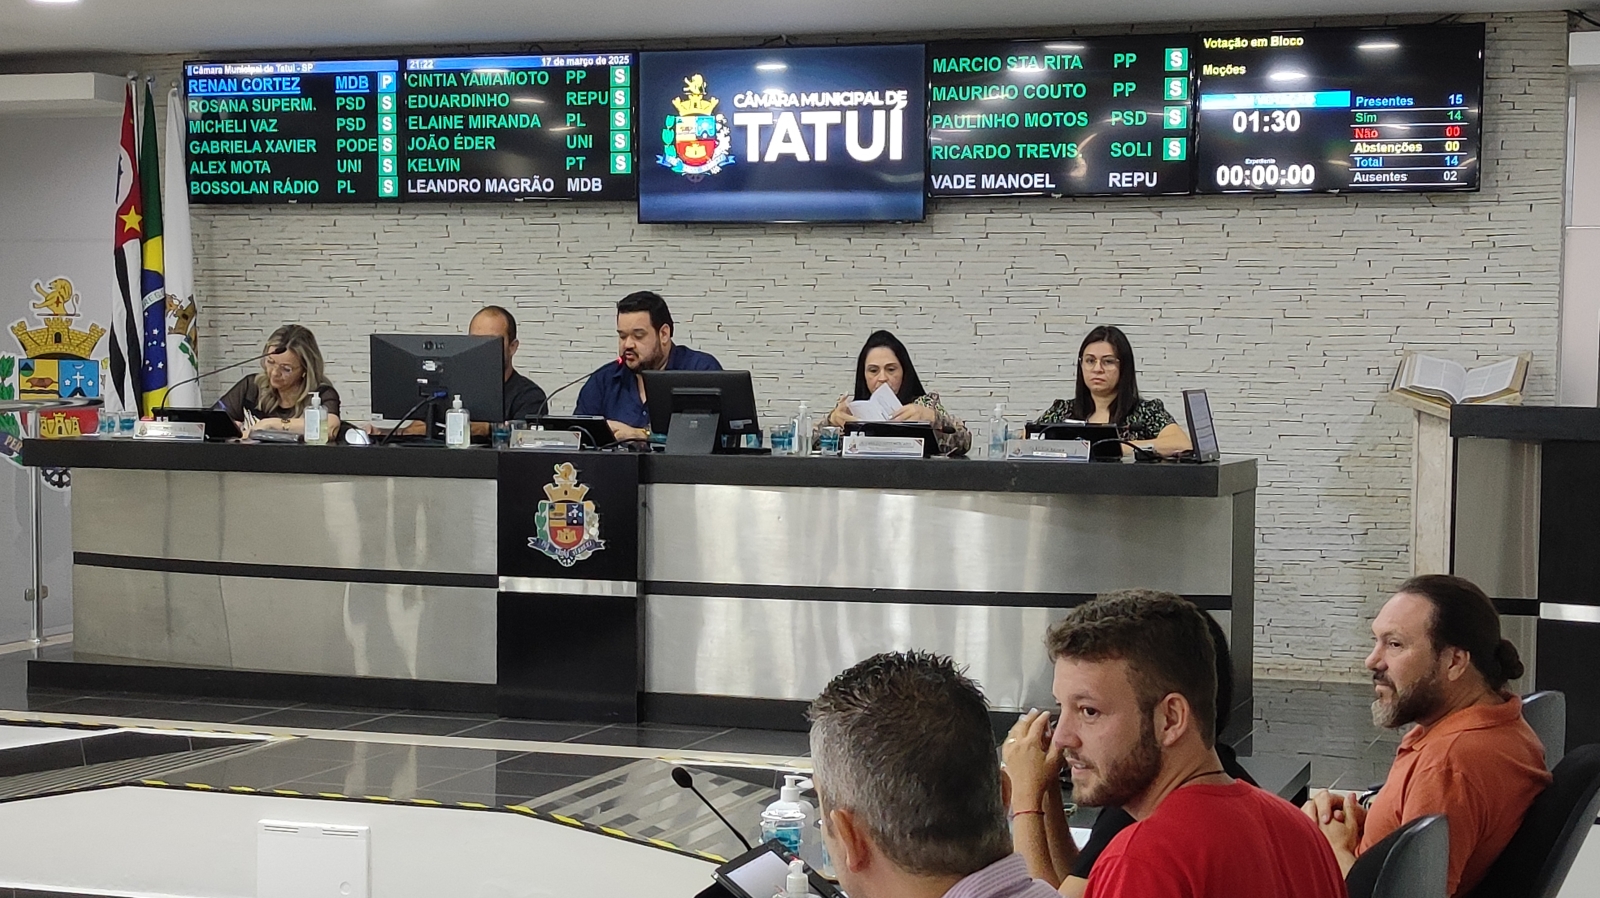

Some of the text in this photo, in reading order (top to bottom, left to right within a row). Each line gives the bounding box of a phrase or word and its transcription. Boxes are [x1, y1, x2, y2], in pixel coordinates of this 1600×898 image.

[1203, 36, 1304, 49] Votação em Bloco
[409, 60, 434, 68] 21:22
[542, 56, 629, 67] 17 de março de 2025
[933, 52, 1182, 73] MARCIO STA RITA PP S
[1203, 64, 1246, 76] Moções
[188, 75, 392, 92] RENAN CORTEZ MDB P
[407, 68, 625, 88] CINTIA YAMAMOTO PP S
[408, 90, 625, 108] EDUARDINHO REPU S
[734, 90, 908, 108] CÂMARA MUNICIPAL DE
[933, 80, 1182, 101] MAURICIO COUTO PP S
[189, 96, 392, 113] ROSANA SUPERM. PSD S
[1356, 96, 1413, 107] Presentes
[1449, 94, 1463, 105] 15
[408, 112, 625, 129] ELAINE MIRANDA PL S
[932, 109, 1181, 128] PAULINHO MOTOS PSD S
[1233, 110, 1300, 132] 01:30
[1356, 110, 1461, 122] Sim 14
[189, 117, 392, 133] MICHELI VAZ PSD S
[734, 103, 906, 162] TATUÍ
[1355, 127, 1460, 138] Não 00
[189, 137, 393, 154] GABRIELA XAVIER PODE S
[408, 133, 626, 150] JOÃO ÉDER UNI S
[1354, 141, 1460, 154] Abstenções 00
[931, 145, 1010, 160] RICARDO
[1110, 142, 1151, 157] SOLI
[1168, 141, 1180, 157] S
[190, 158, 393, 174] ALEX MOTA UNI S
[408, 155, 626, 172] KELVIN PT S
[1354, 156, 1458, 167] Total 14
[931, 172, 1157, 189] VADE MANOEL REPU
[1217, 164, 1315, 186] 00:00:00
[1354, 171, 1457, 182] Ausentes 02
[190, 177, 393, 195] BOSSOLAN RÁDIO PL S
[408, 176, 602, 193] LEANDRO MAGRÃO MDB
